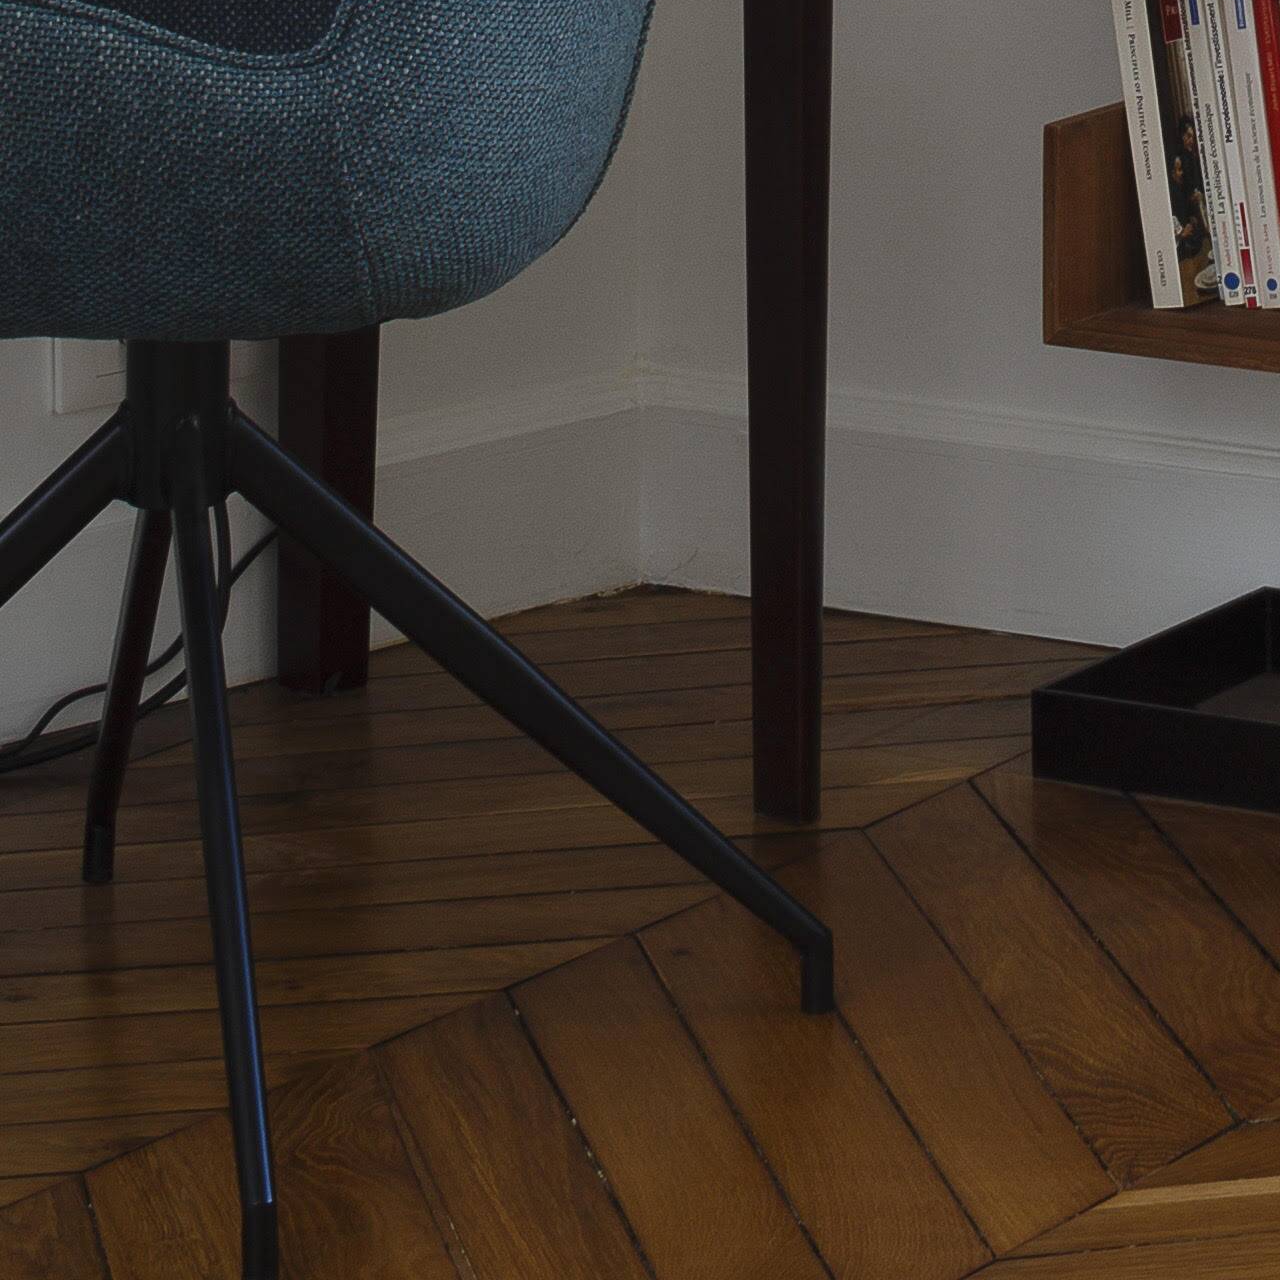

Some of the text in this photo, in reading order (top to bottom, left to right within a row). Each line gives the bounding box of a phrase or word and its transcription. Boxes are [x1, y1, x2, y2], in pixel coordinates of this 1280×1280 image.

[1123, 0, 1152, 181] MILL PRINCIPLES OF POLITICAL ECONOMY
[1207, 2, 1233, 143] Macroéconomie l'investissement
[1205, 103, 1226, 214] La politique économique
